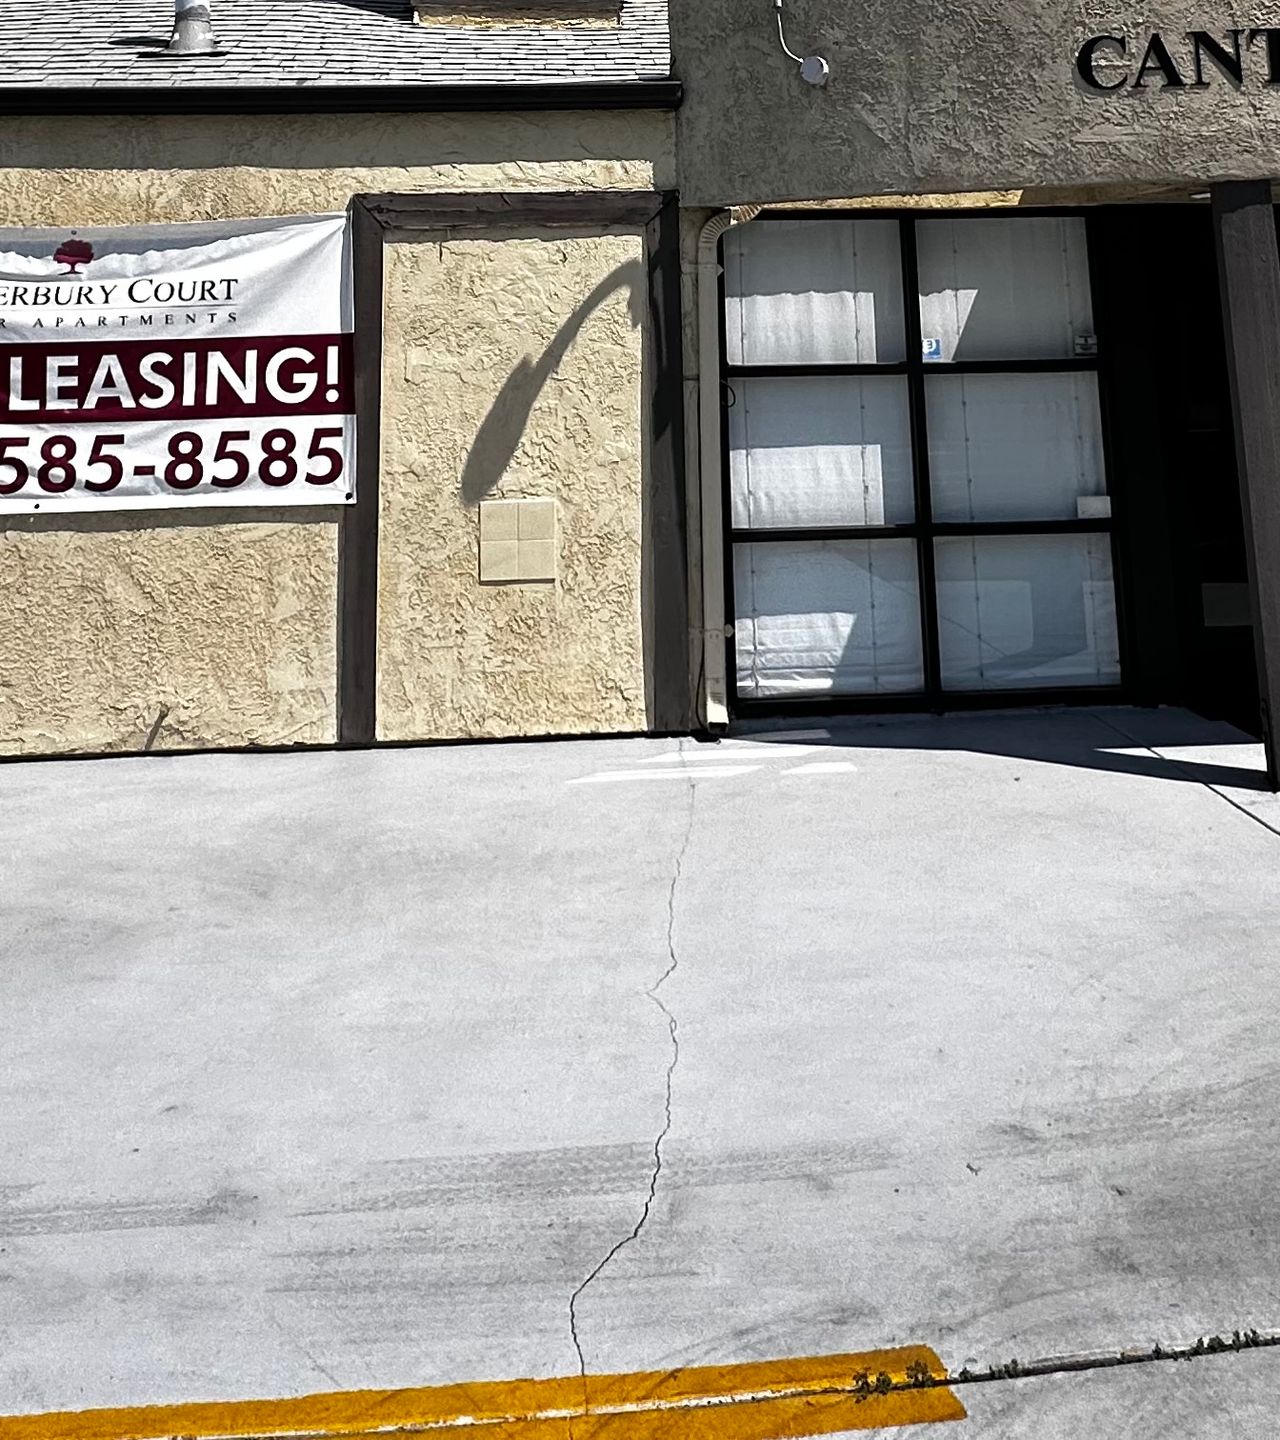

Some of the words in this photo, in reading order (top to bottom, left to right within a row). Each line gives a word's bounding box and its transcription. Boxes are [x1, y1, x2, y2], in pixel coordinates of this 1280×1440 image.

[127, 277, 240, 303] COURT
[32, 311, 239, 329] APARTMENTS
[8, 345, 341, 411] LEASING!
